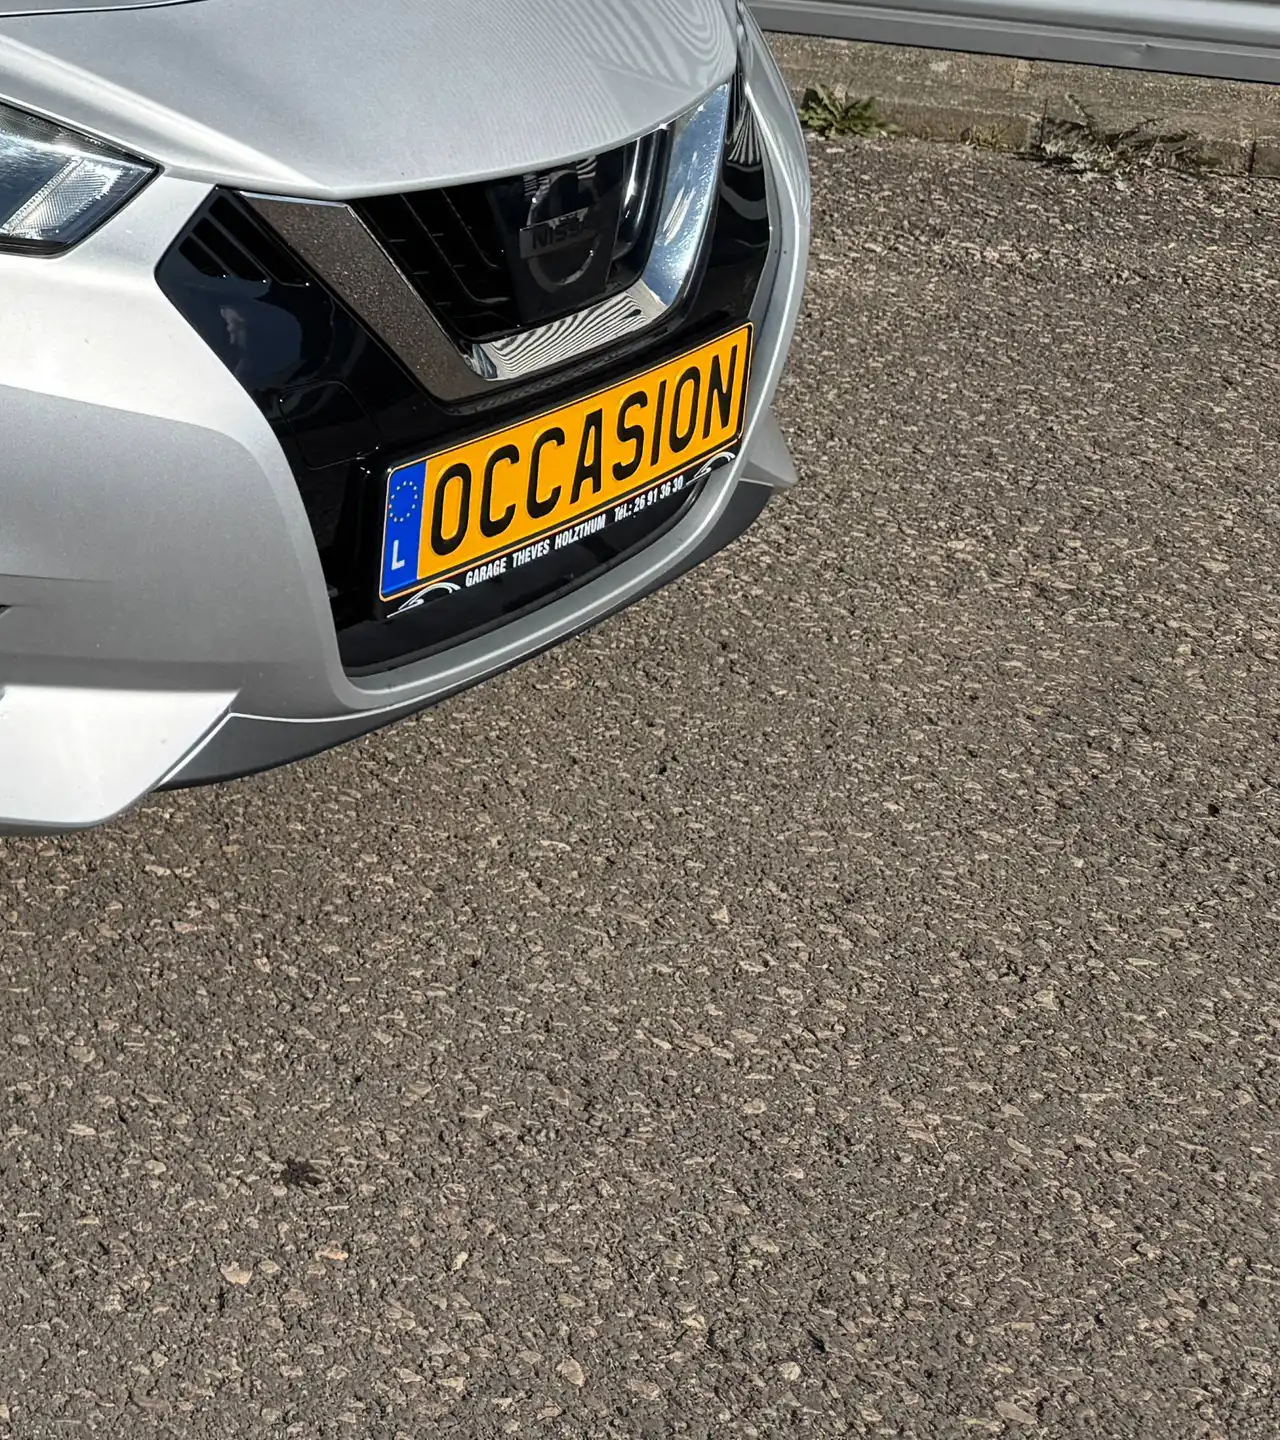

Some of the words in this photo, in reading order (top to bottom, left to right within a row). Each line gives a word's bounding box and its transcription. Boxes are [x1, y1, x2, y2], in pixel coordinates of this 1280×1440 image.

[533, 212, 594, 250] NISSA
[430, 344, 739, 557] OCCASION
[391, 539, 405, 571] L
[465, 557, 507, 587] GARAGE
[512, 540, 550, 569] THEVES
[554, 513, 606, 550] HOLZTHUM
[633, 495, 646, 511] 26
[646, 490, 658, 506] 91
[659, 484, 671, 500] 36
[672, 475, 684, 492] 30
